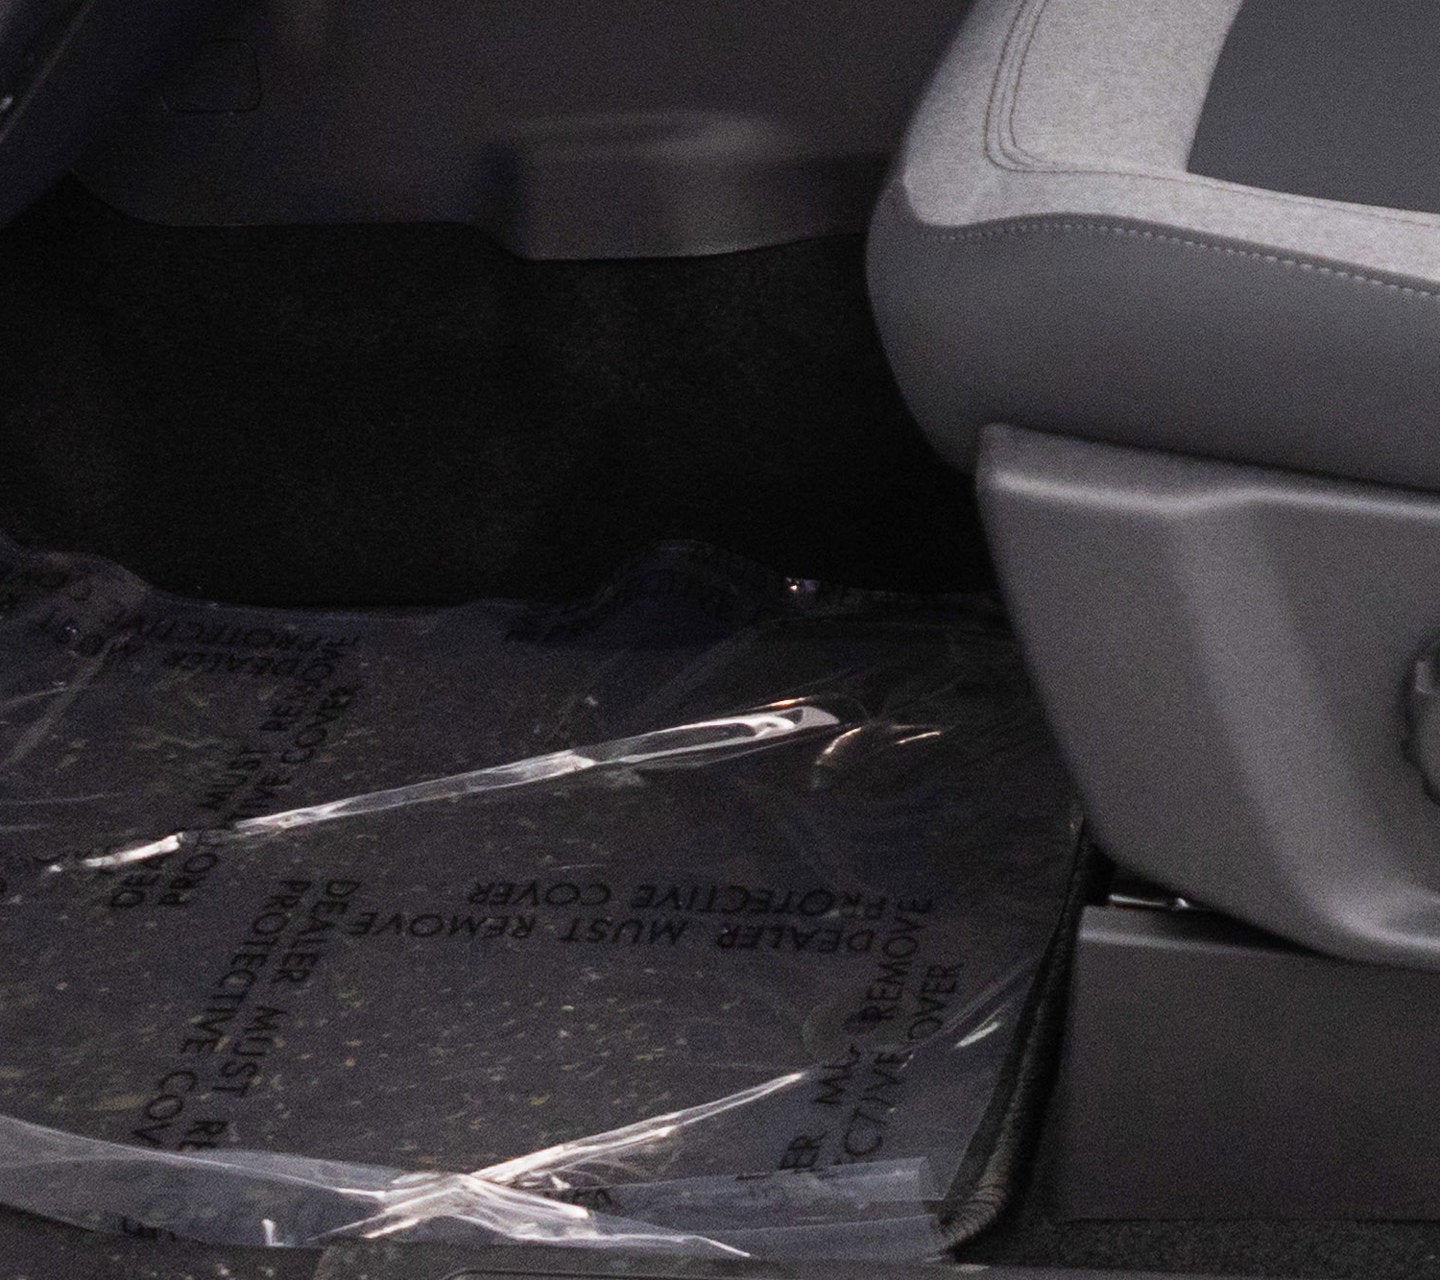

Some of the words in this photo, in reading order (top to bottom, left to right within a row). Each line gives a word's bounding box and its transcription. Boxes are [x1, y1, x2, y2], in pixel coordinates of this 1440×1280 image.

[466, 881, 611, 908] COVER
[629, 883, 887, 921] PROTECTIVE
[272, 880, 361, 984] DEALER
[342, 911, 538, 940] REMOVE
[559, 917, 689, 946] MUST
[713, 923, 876, 955] DEALER
[180, 880, 312, 1054] PROTECTIVE
[907, 963, 963, 1041] OVER
[212, 1005, 287, 1098] MUST
[132, 1070, 198, 1147] COV
